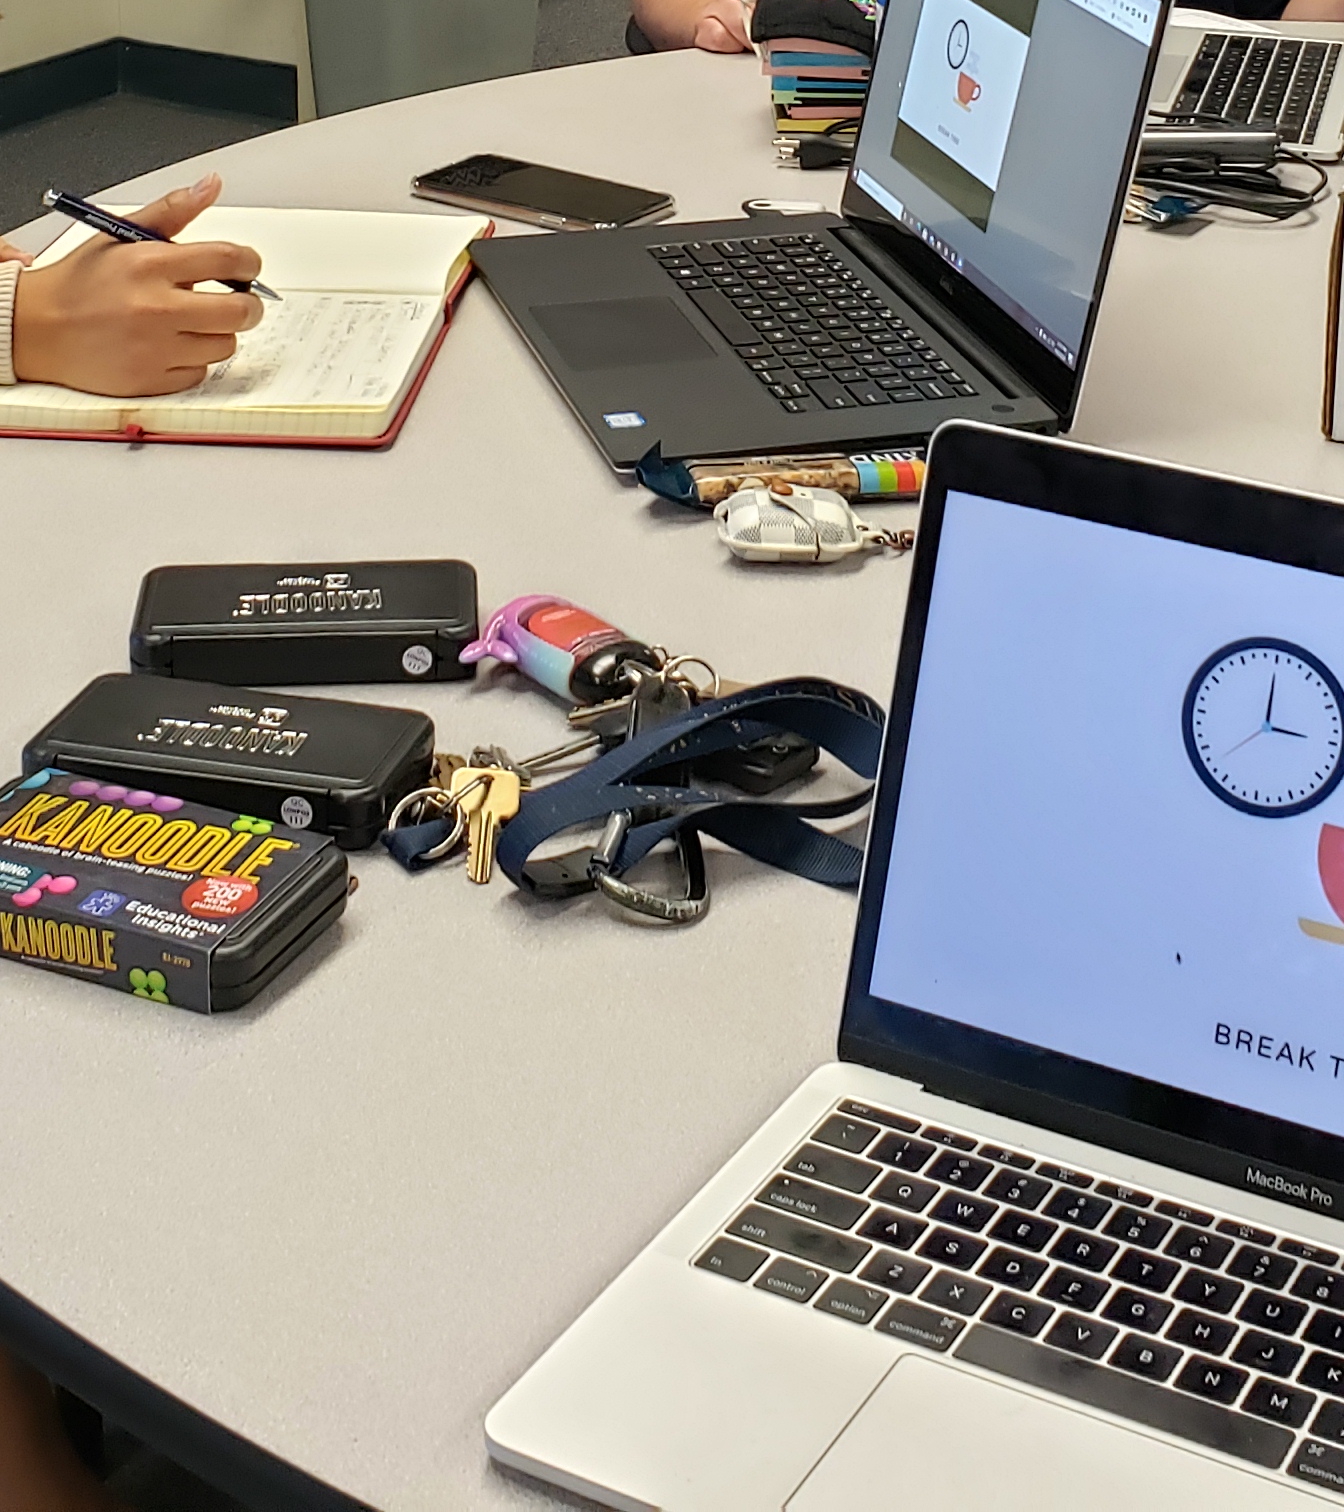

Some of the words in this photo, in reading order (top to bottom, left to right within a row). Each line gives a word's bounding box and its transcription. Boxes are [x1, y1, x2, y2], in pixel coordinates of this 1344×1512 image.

[239, 589, 382, 616] KANOODLE
[151, 718, 308, 756] KANOODLE
[13, 841, 60, 855] caboodle
[61, 849, 72, 858] of
[74, 851, 146, 874] brain-teasing
[145, 867, 193, 881] puzzles!
[203, 885, 242, 901] 200
[126, 900, 226, 934] Educational
[132, 914, 198, 938] Insights
[0, 912, 117, 970] KANOODLE
[1215, 1022, 1317, 1073] BREAK
[797, 1161, 815, 1173] tab
[1247, 1166, 1308, 1200] MacBook
[1309, 1186, 1333, 1208] Pro
[770, 1191, 793, 1204] caps
[795, 1197, 817, 1214] lock
[741, 1225, 766, 1238] shift
[767, 1275, 806, 1296] control
[831, 1298, 866, 1317] option
[889, 1319, 944, 1344] command
